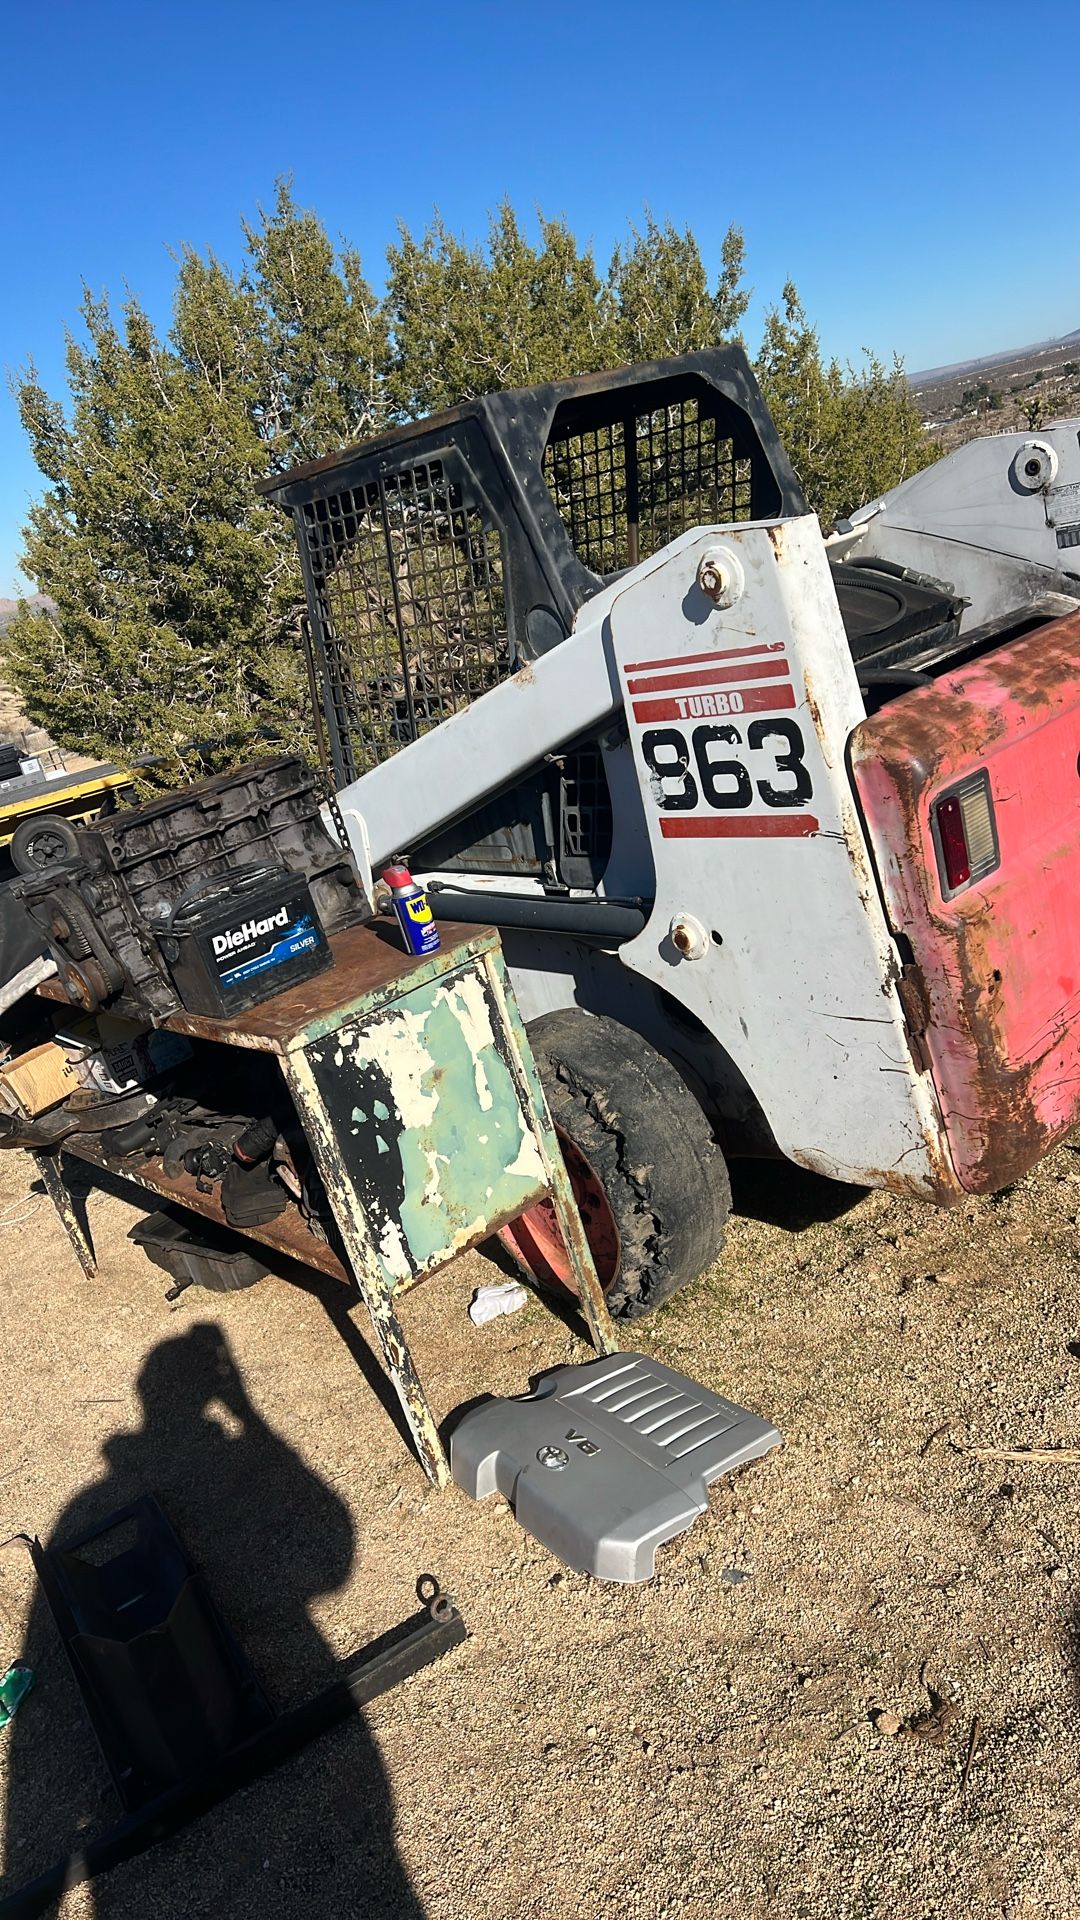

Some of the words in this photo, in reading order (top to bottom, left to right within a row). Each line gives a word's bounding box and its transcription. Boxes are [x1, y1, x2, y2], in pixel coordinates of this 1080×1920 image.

[675, 692, 744, 719] TURBO
[641, 717, 813, 811] 863
[212, 906, 289, 955] DieHard
[289, 936, 315, 953] SILVER
[216, 950, 237, 963] POWER
[565, 1428, 601, 1457] V6
